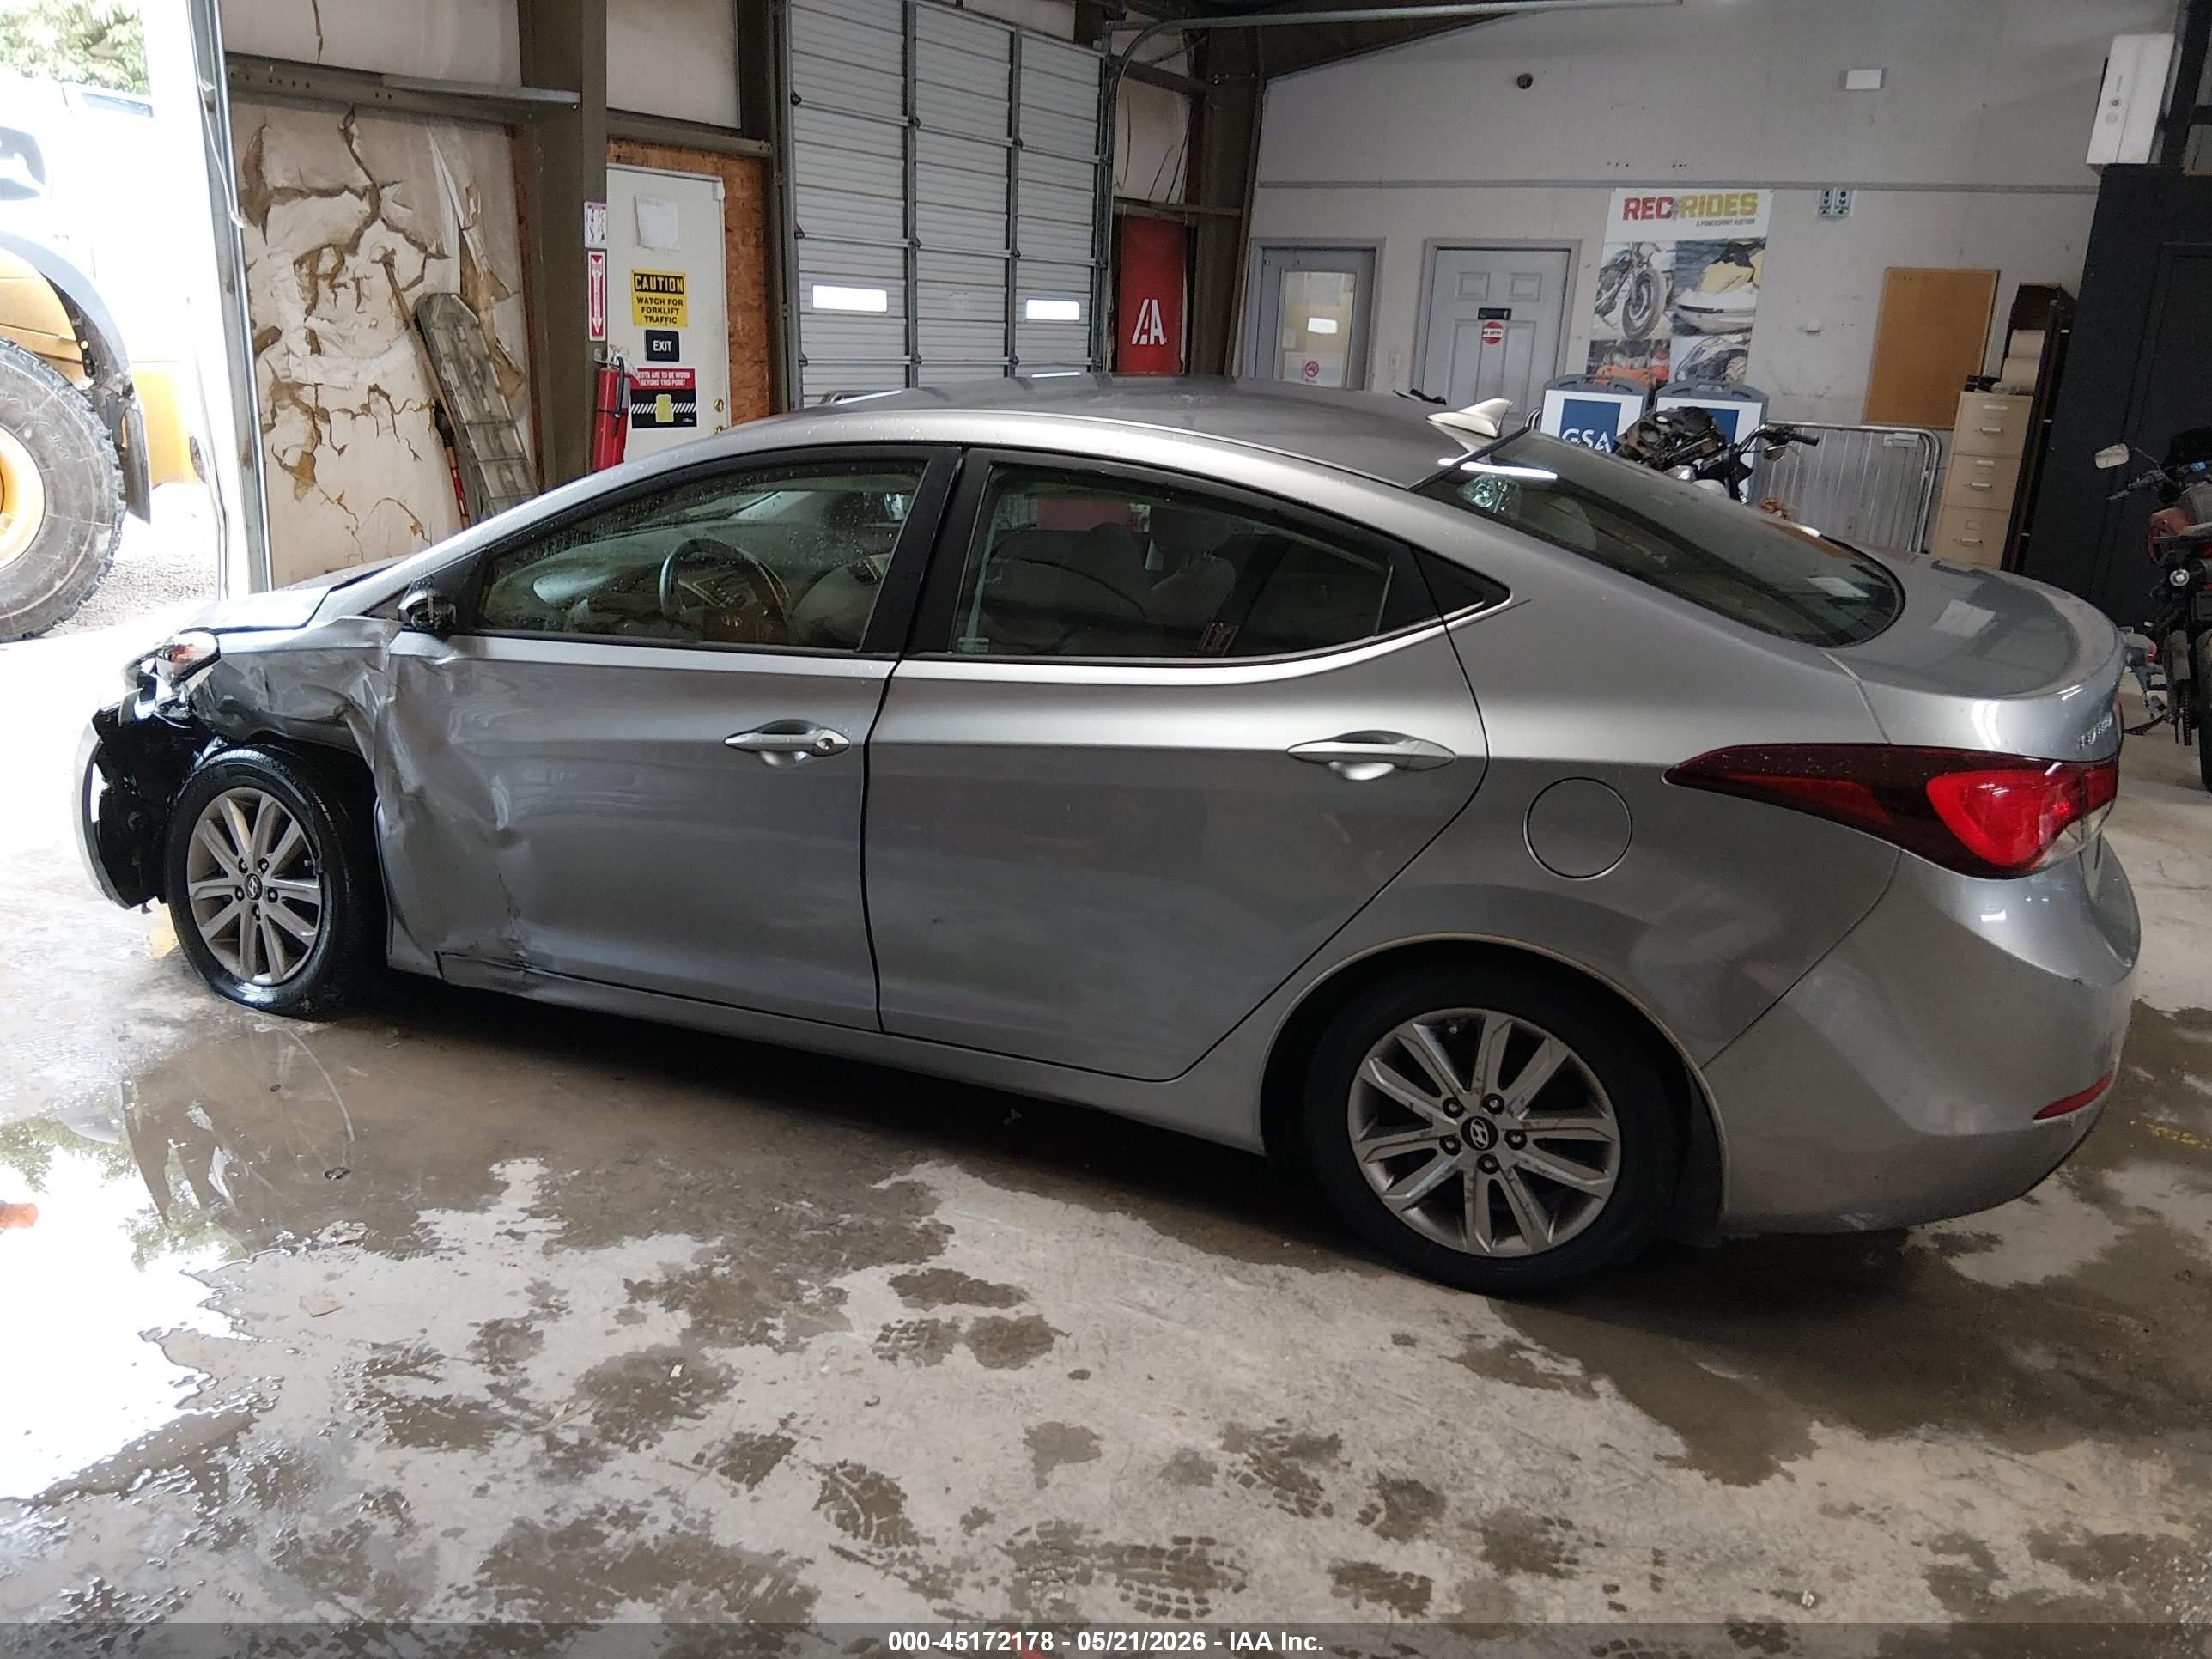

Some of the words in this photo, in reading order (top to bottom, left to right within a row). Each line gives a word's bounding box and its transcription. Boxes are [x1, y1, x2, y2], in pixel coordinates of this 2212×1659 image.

[1679, 192, 1759, 219] RIDES
[635, 275, 684, 292] CAUTION
[636, 296, 665, 305] WATCH
[641, 307, 680, 315] FORKLIFT
[644, 315, 678, 324] TRAFFIC
[653, 340, 672, 352] EXIT
[1562, 428, 1612, 453] GSA
